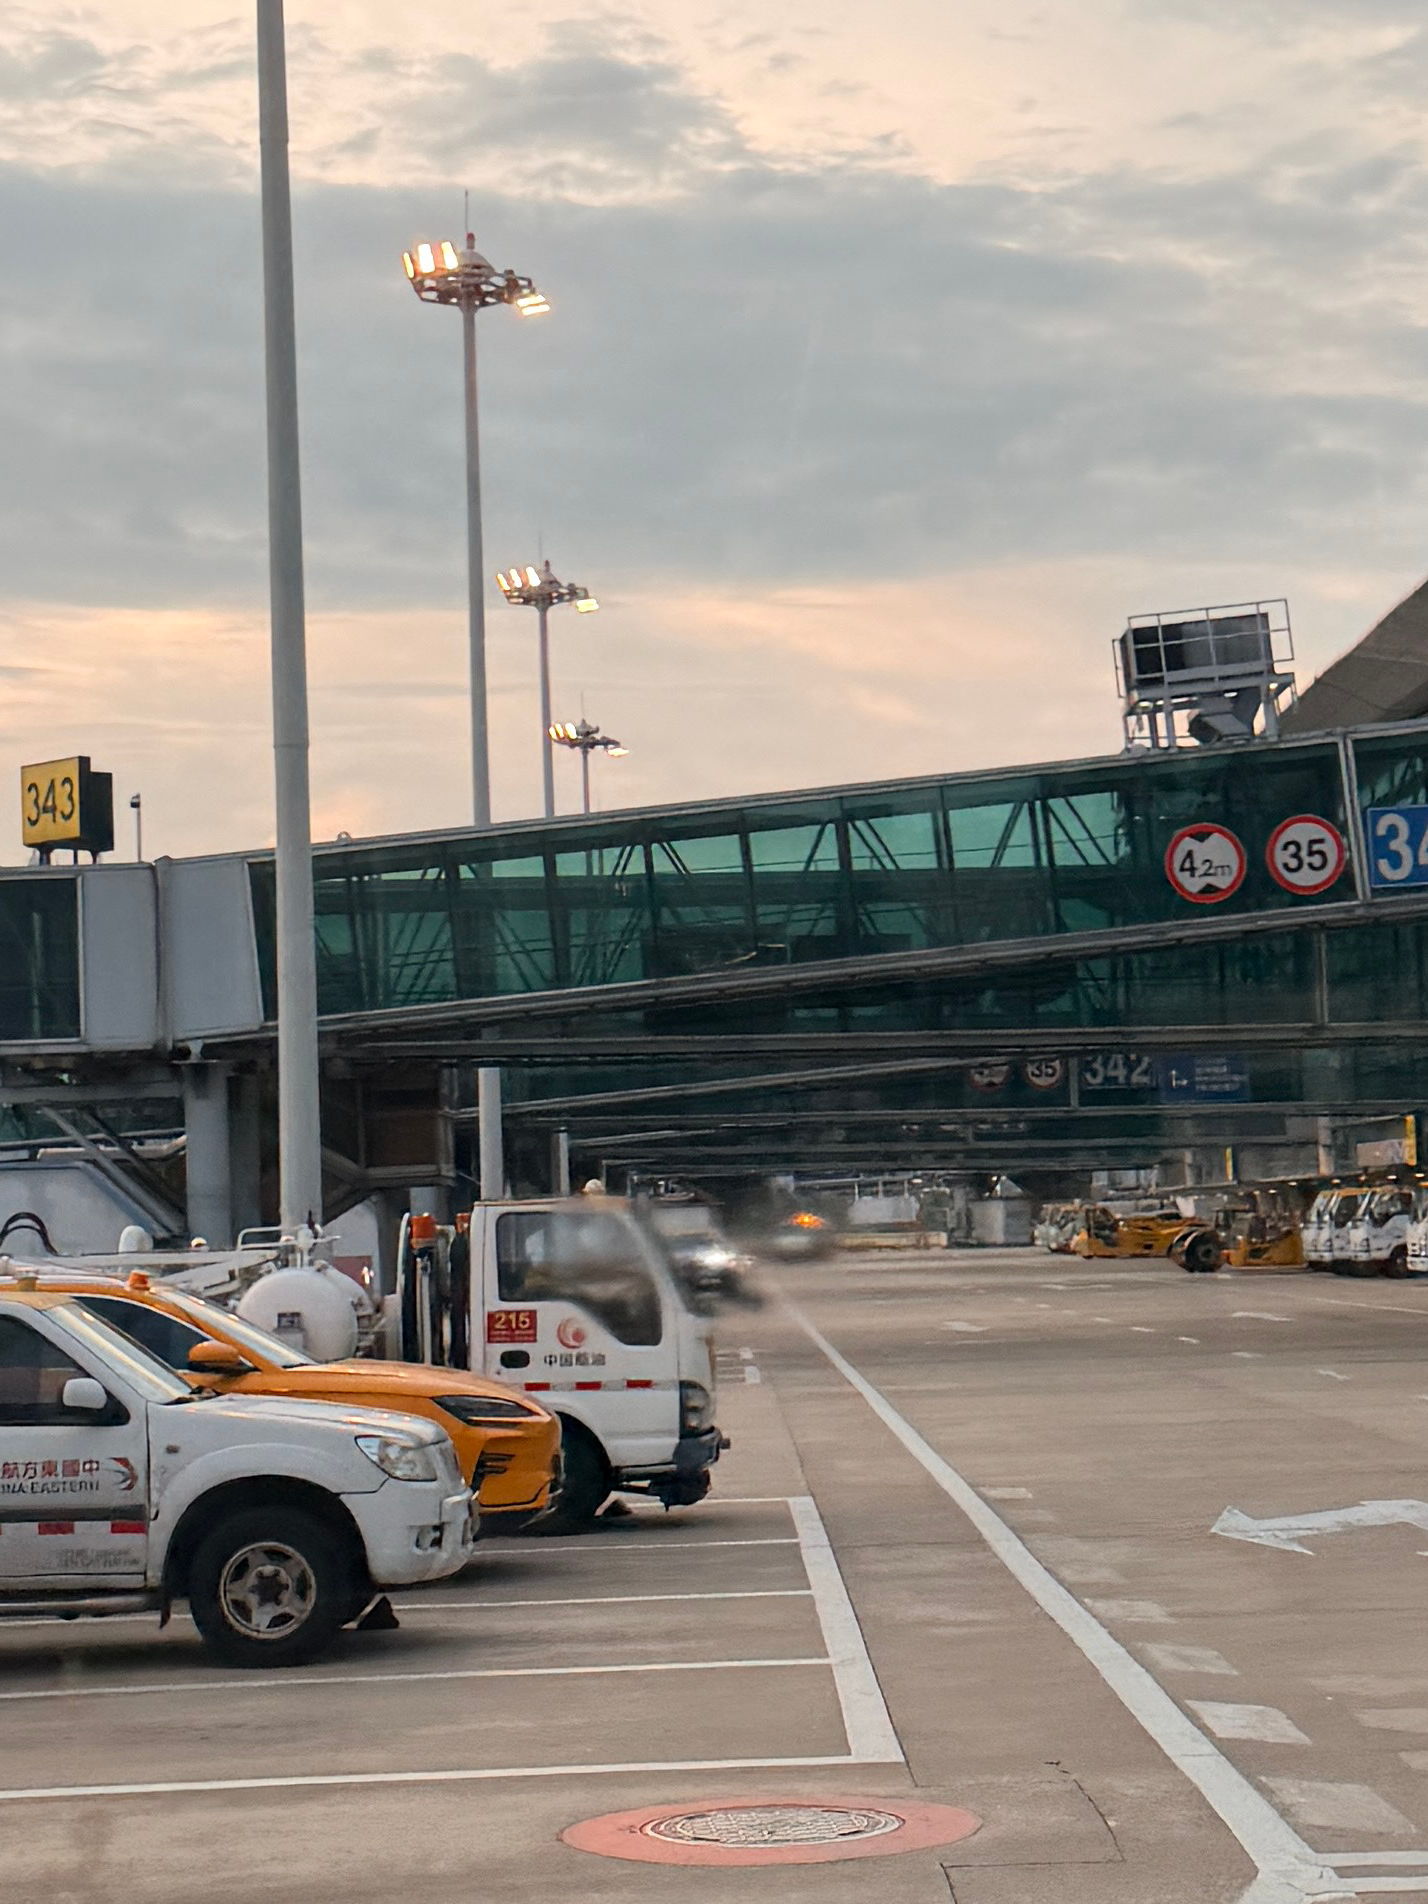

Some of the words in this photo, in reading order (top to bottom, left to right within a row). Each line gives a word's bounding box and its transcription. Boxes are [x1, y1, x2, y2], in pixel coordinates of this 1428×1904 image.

[25, 776, 76, 828] 343
[1281, 838, 1329, 873] 35
[1083, 1053, 1152, 1086] 342
[493, 1311, 532, 1329] 215
